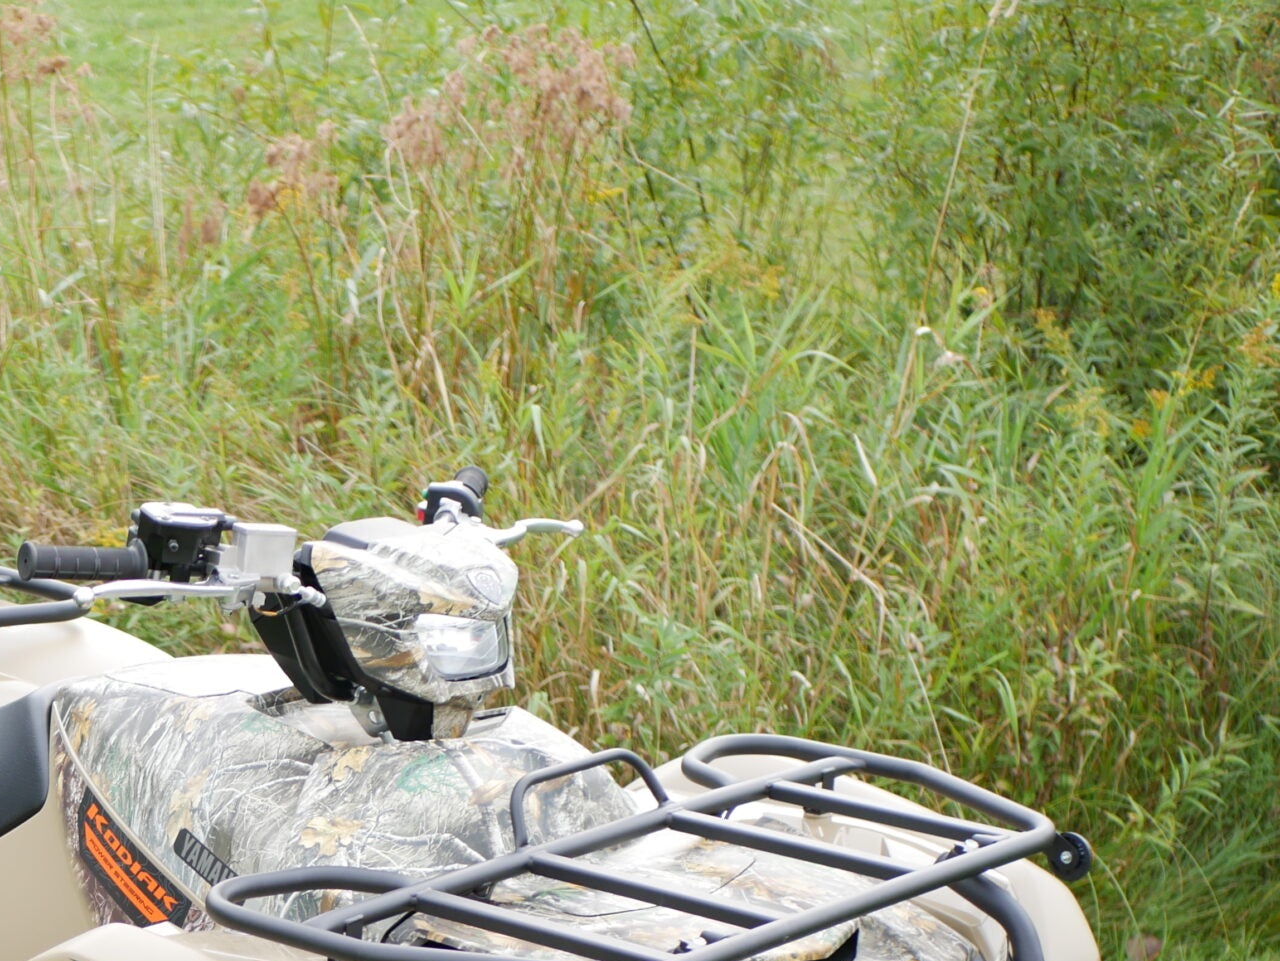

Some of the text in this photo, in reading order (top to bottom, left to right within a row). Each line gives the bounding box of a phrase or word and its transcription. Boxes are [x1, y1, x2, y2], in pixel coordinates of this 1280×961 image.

[86, 803, 179, 912] KODIAK
[89, 839, 154, 915] POWER STEERING
[180, 832, 237, 887] YAMA
